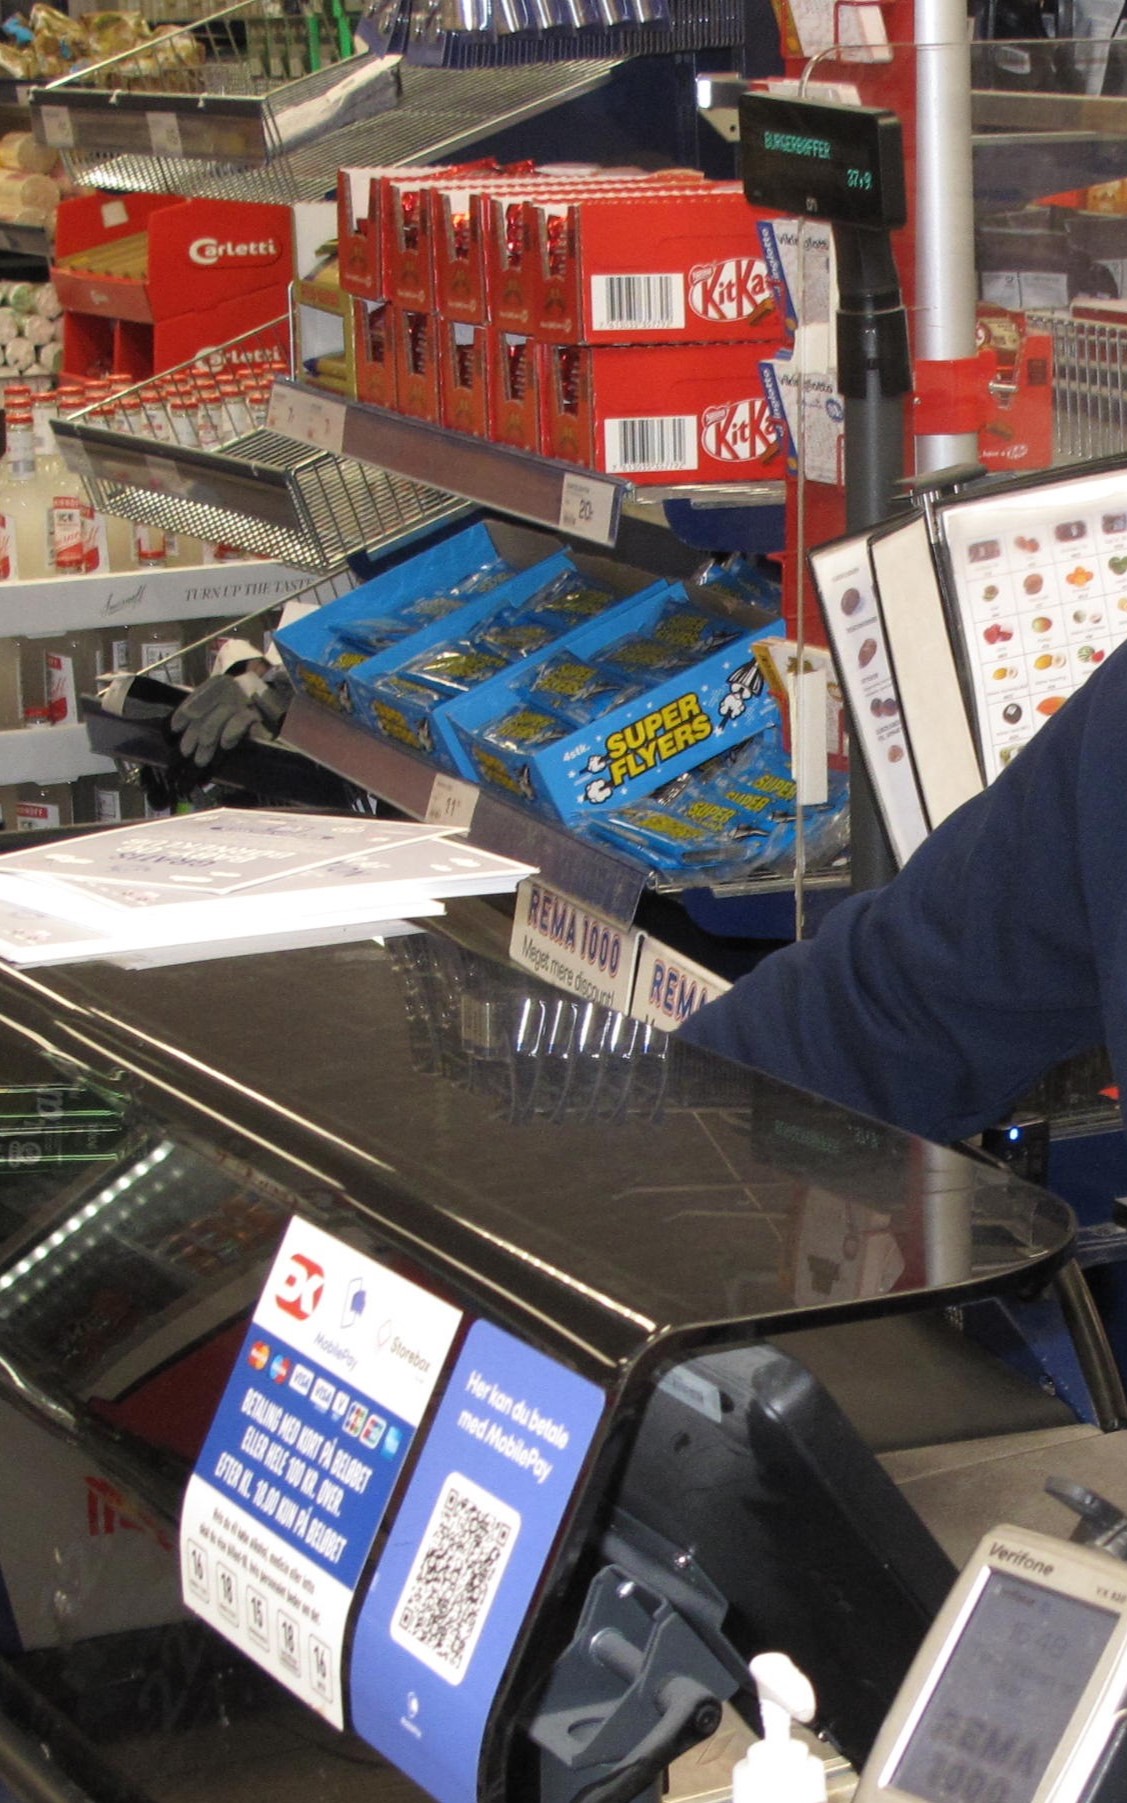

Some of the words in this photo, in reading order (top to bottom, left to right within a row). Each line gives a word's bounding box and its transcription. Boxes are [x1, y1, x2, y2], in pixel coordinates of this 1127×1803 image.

[189, 237, 277, 265] Carletti
[605, 692, 702, 759] SUPER
[609, 713, 713, 787] FLYERS
[521, 934, 550, 972] Meget
[549, 958, 575, 987] mere
[527, 884, 577, 953] REMA
[580, 916, 621, 979] 1000
[241, 1387, 284, 1433] BETALING
[277, 1412, 301, 1446] MED
[296, 1425, 324, 1461] KORT
[318, 1437, 339, 1471] PÅ
[330, 1449, 374, 1495] BELØBET
[241, 1424, 270, 1462] ELLER
[465, 1370, 491, 1400] Her
[487, 1384, 514, 1415] kan
[511, 1400, 531, 1426] du
[528, 1407, 570, 1451] betale
[214, 1451, 244, 1489] EFTER
[457, 1410, 490, 1440] med
[484, 1423, 554, 1484] MobilePay
[989, 1541, 1056, 1577] Verifone
